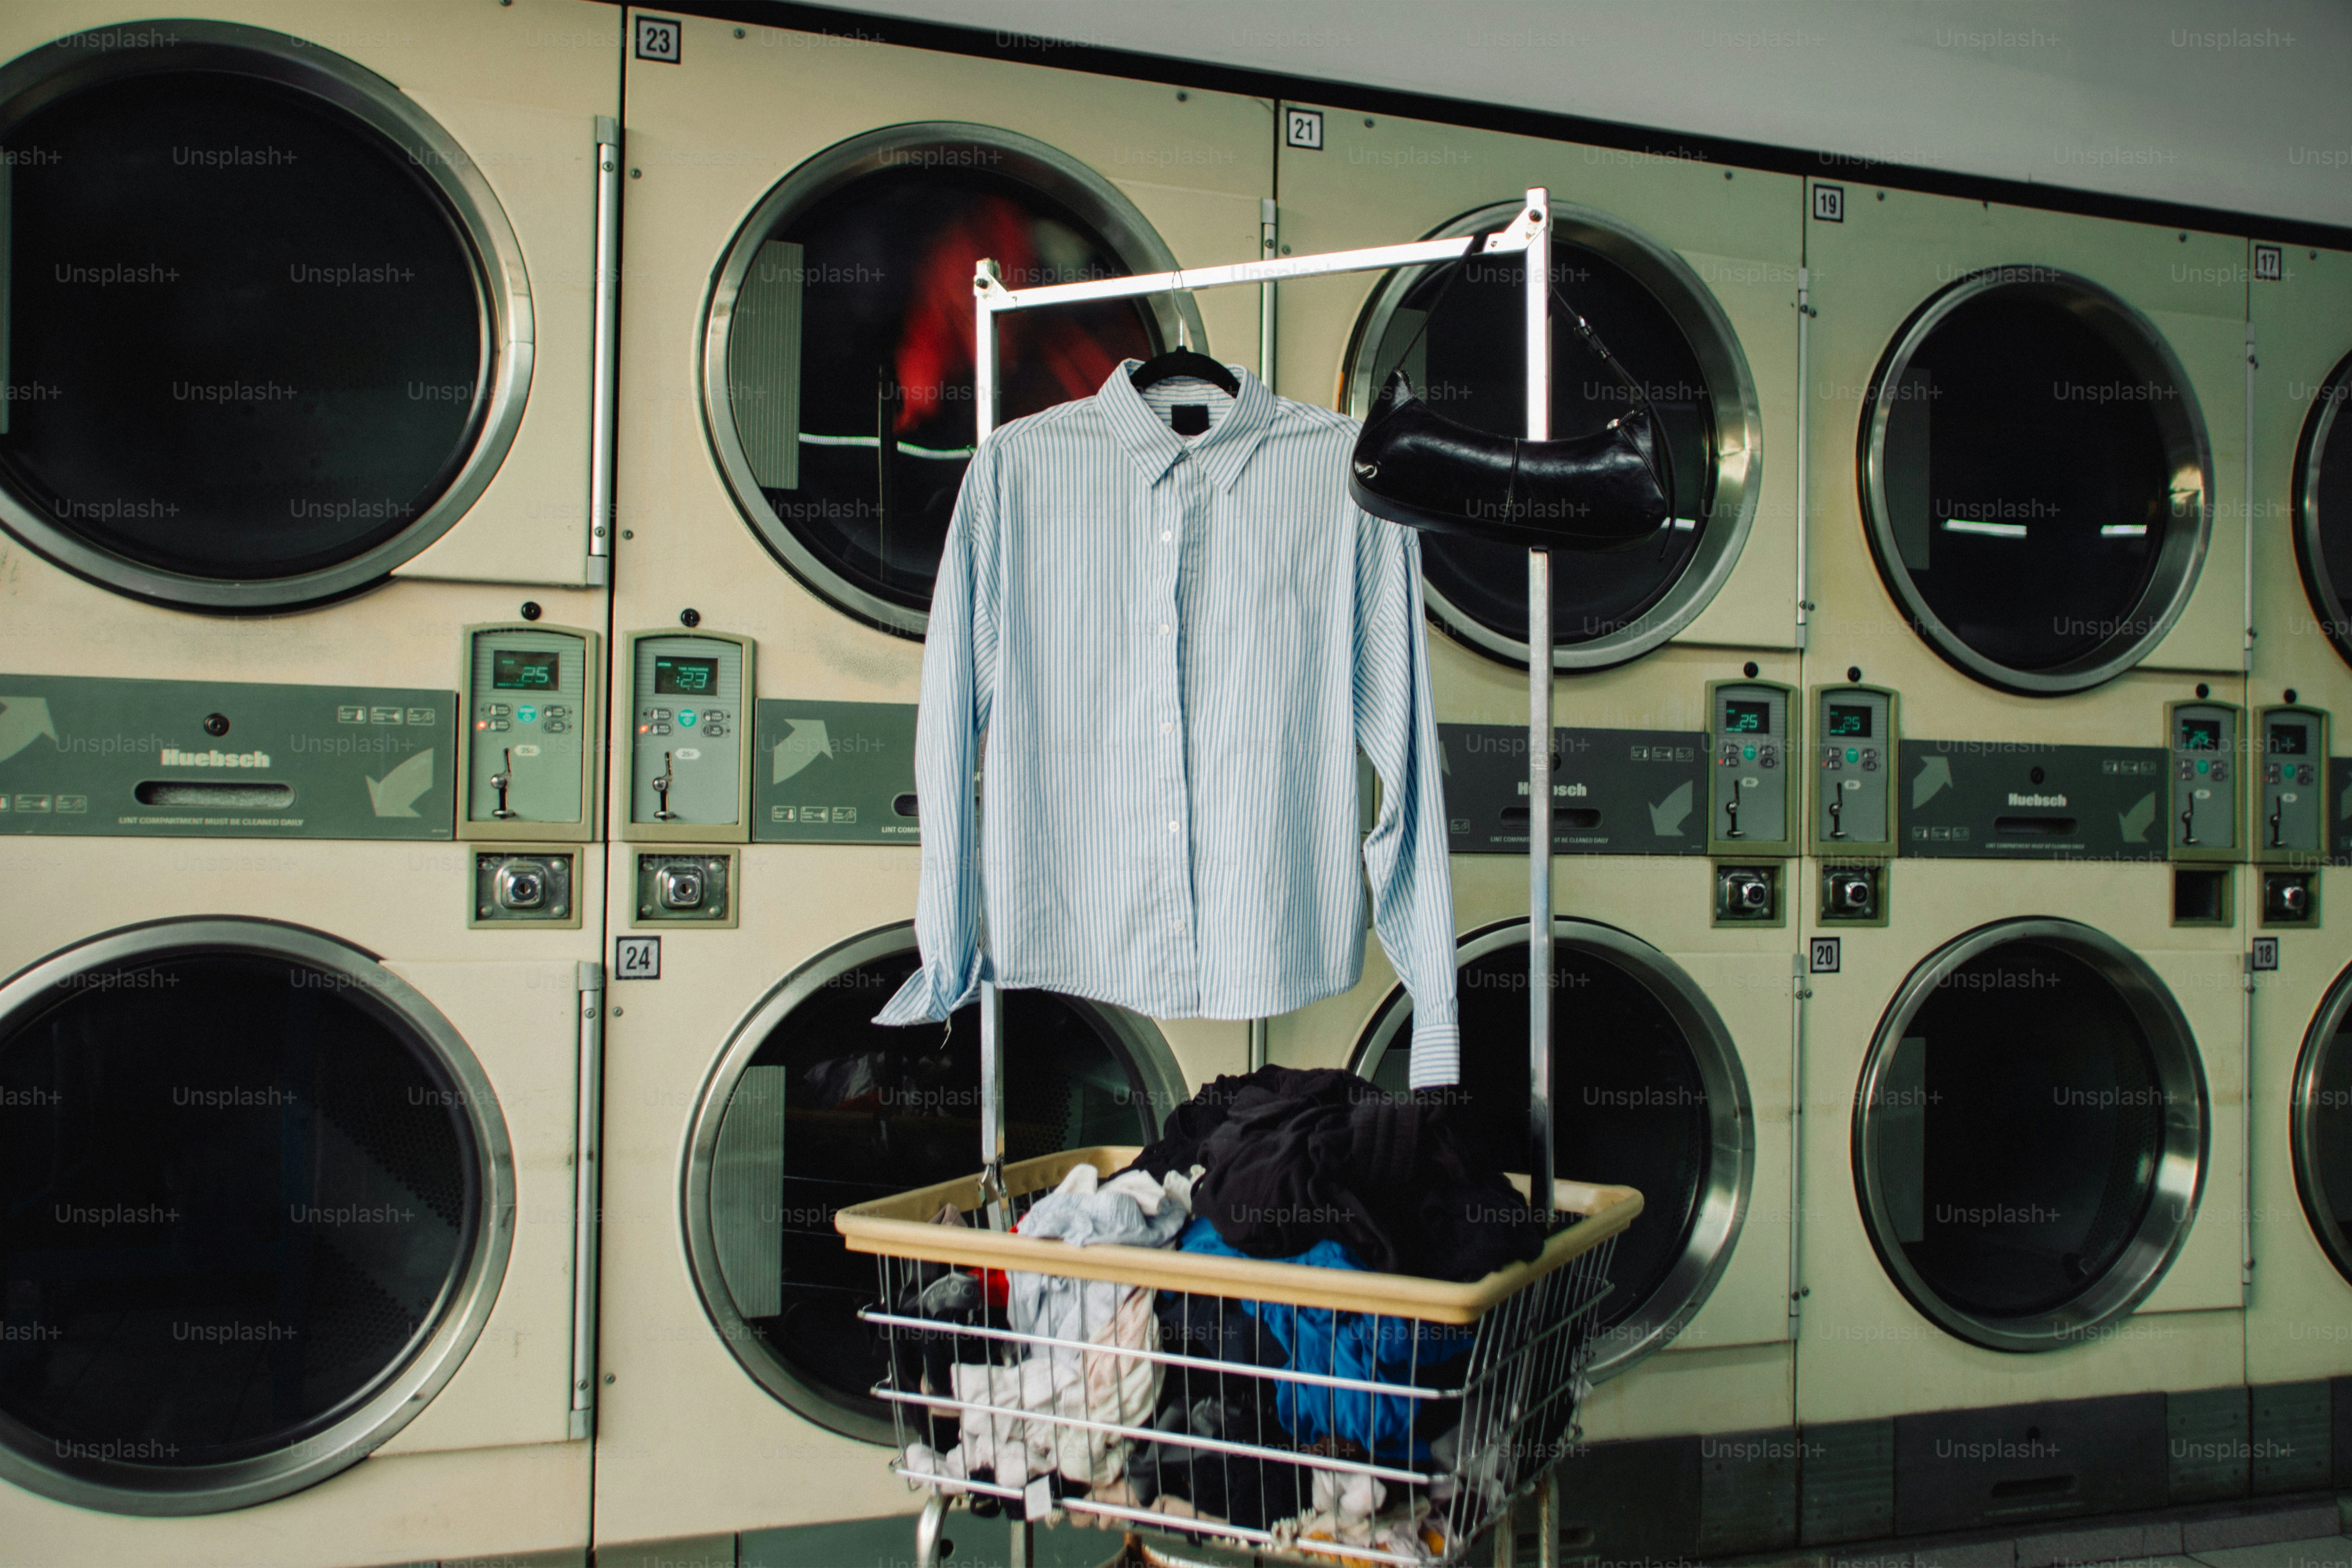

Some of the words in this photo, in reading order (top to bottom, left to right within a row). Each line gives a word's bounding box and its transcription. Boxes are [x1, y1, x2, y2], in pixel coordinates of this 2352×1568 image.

[646, 28, 670, 54] 23
[1295, 118, 1313, 140] 21
[1821, 194, 1837, 214] 19
[2261, 254, 2275, 271] 17
[161, 748, 269, 768] Huebsch
[2008, 793, 2067, 807] Huebsch
[139, 817, 203, 825] COMPARTMENT
[242, 818, 279, 826] CLEANED
[280, 818, 304, 826] DAILY
[626, 946, 650, 970] 24
[1817, 945, 1833, 965] 20
[2258, 944, 2272, 964] 18
